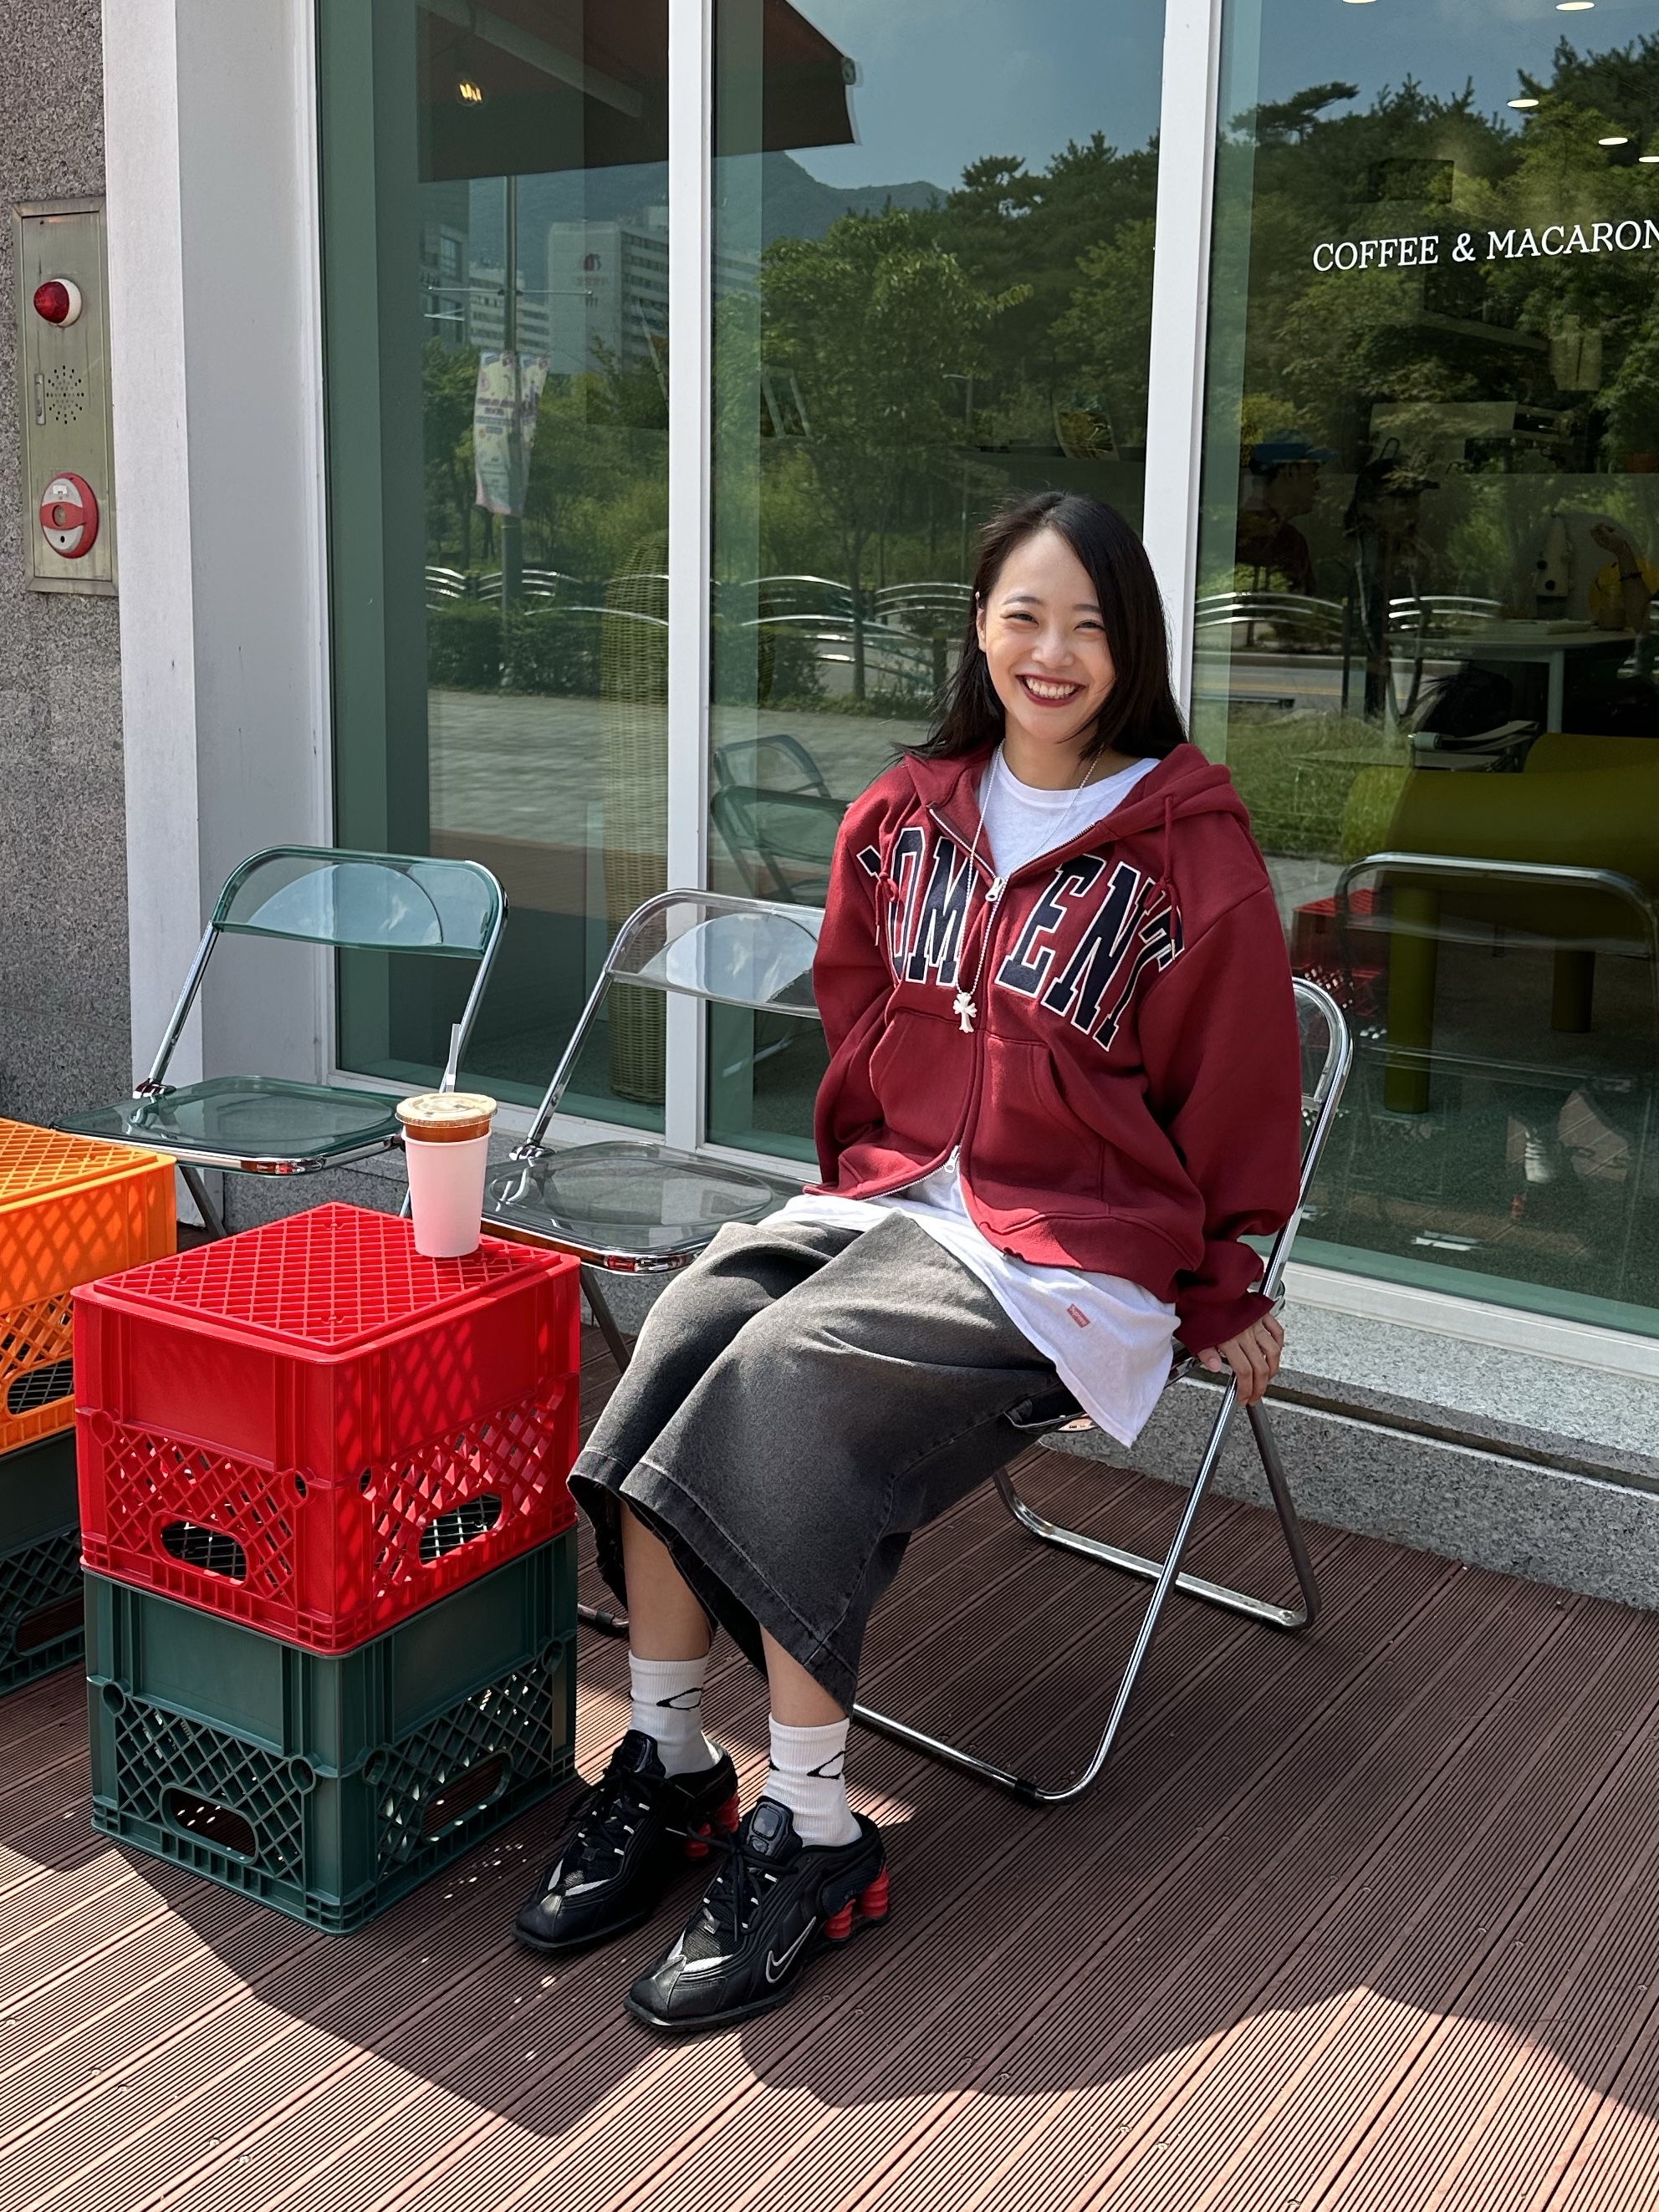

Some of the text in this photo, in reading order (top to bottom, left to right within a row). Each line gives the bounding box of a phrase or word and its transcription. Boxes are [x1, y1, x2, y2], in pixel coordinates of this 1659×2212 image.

[1313, 219, 1659, 272] COFFEE & MACARON
[856, 826, 1185, 1052] OMENT
